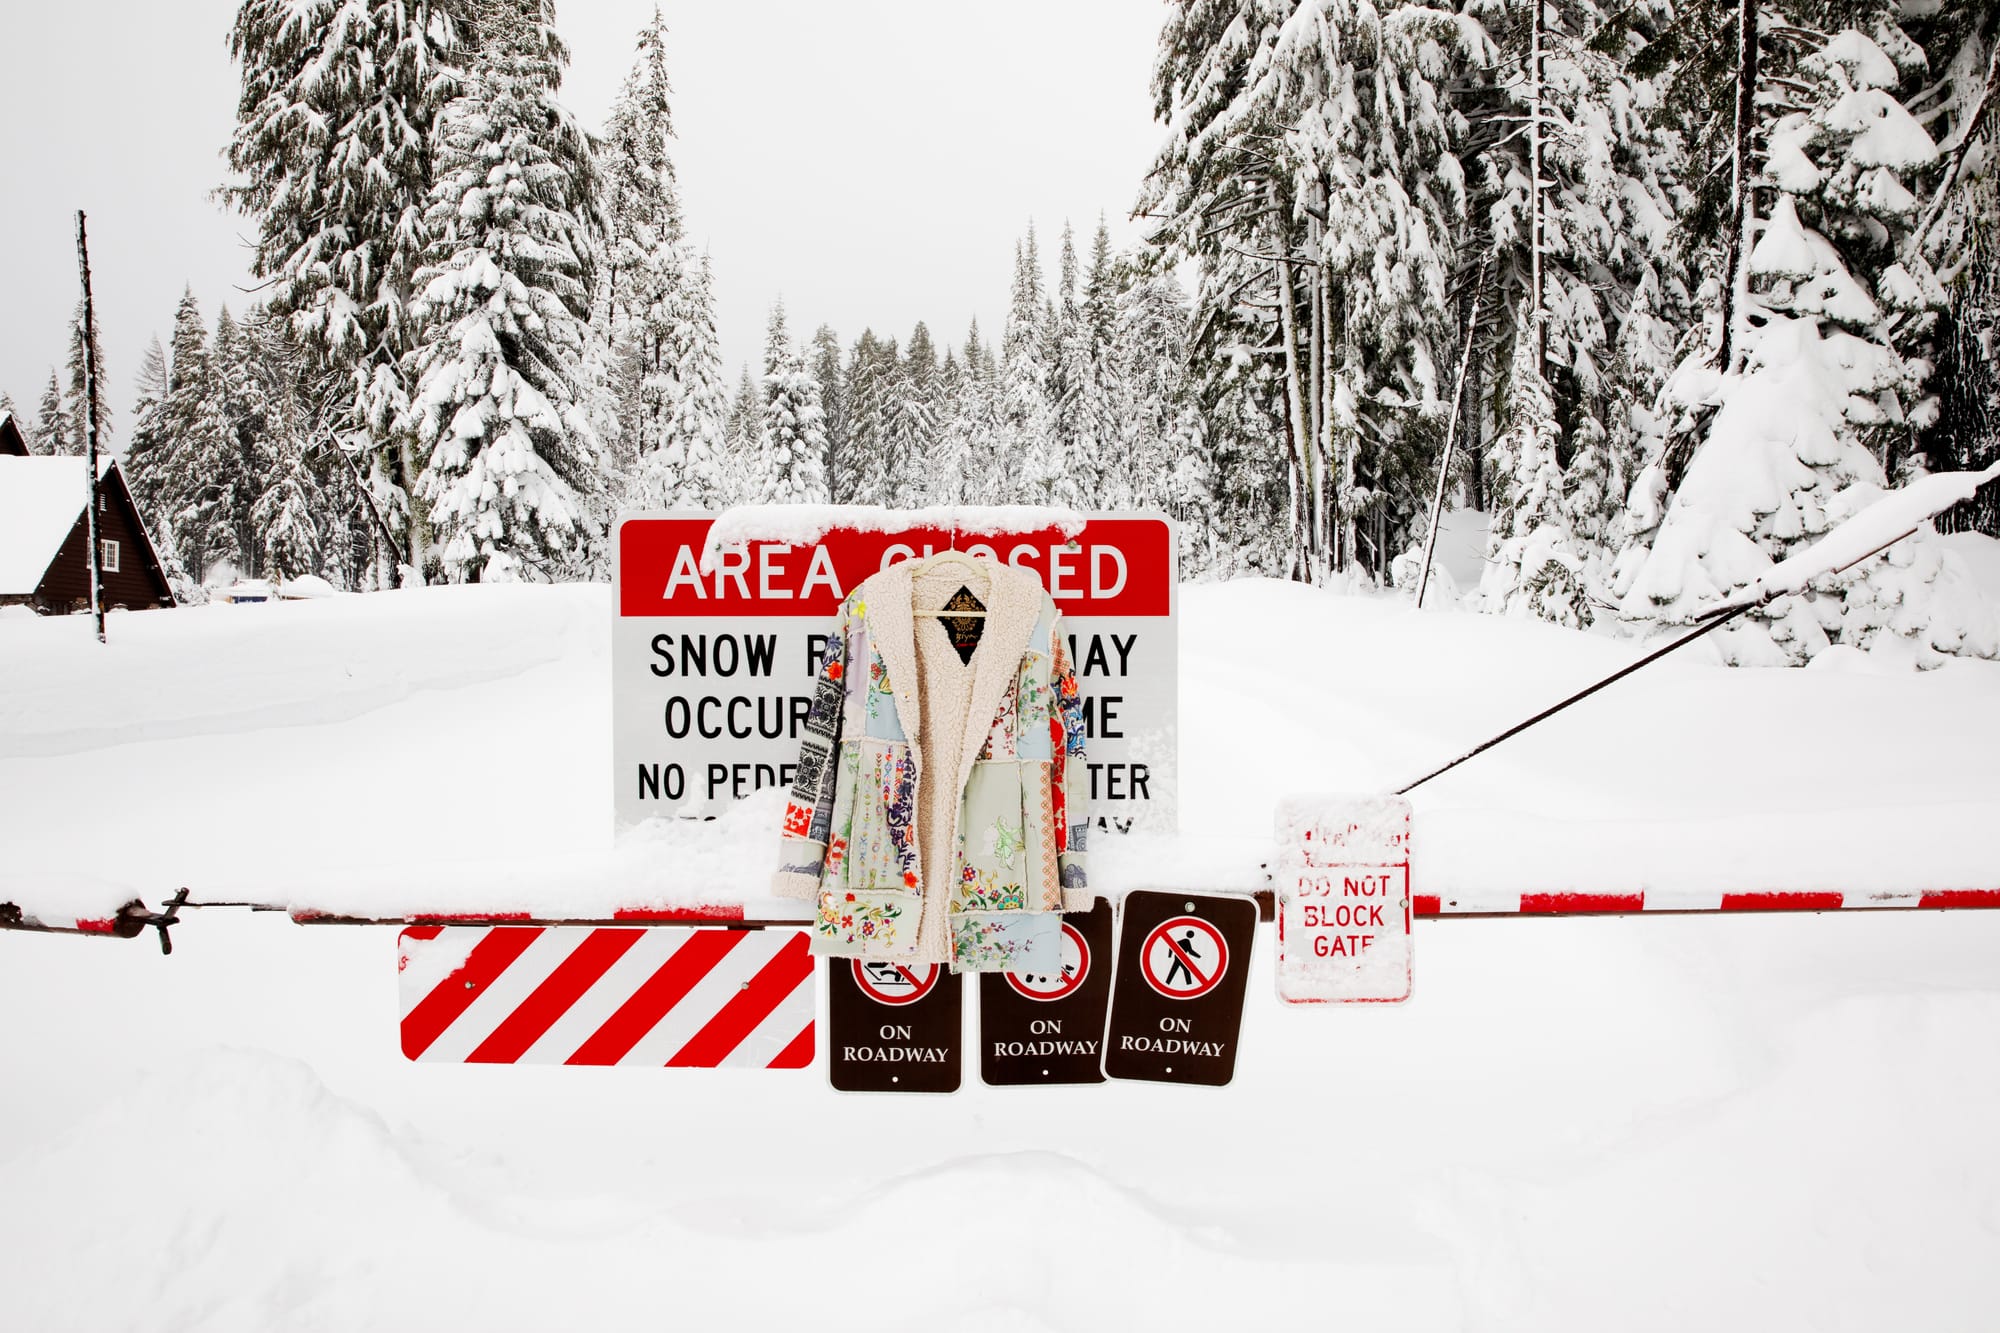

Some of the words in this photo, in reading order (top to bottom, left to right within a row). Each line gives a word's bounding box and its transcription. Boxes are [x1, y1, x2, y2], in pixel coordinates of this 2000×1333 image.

[662, 544, 845, 600] AREA
[650, 633, 777, 678] SNOW
[665, 695, 812, 739] OCCUR
[638, 763, 685, 800] NO
[1086, 763, 1150, 800] TER
[1298, 875, 1331, 897] DO
[1344, 875, 1391, 897] NOT
[1304, 905, 1385, 927] BLOCK
[880, 1025, 912, 1040] ON
[1030, 1020, 1062, 1035] ON
[1159, 1017, 1192, 1034] ON
[843, 1046, 949, 1063] ROADWAY
[993, 1040, 1099, 1057] ROADWAY
[1120, 1035, 1225, 1057] ROADWAY
